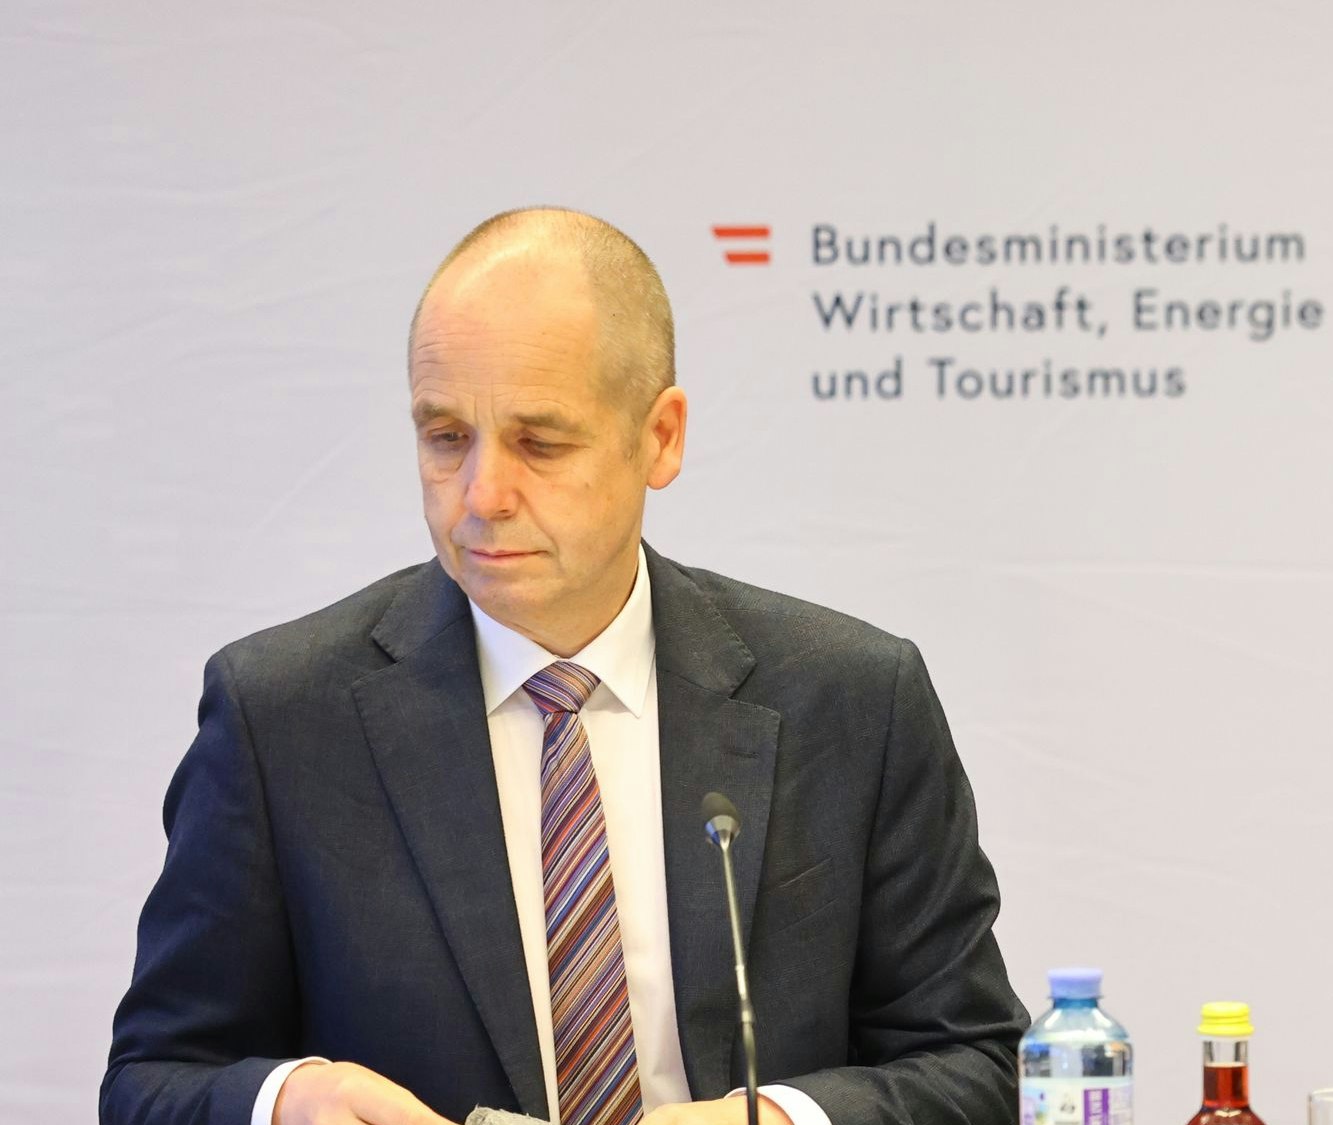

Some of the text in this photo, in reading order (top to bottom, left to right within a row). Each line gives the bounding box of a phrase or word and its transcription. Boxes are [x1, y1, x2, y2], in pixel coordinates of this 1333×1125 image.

[811, 223, 1306, 265] Bundesministerium
[811, 287, 1325, 341] Wirtschaft, Energie
[811, 356, 1187, 400] und Tourismus
